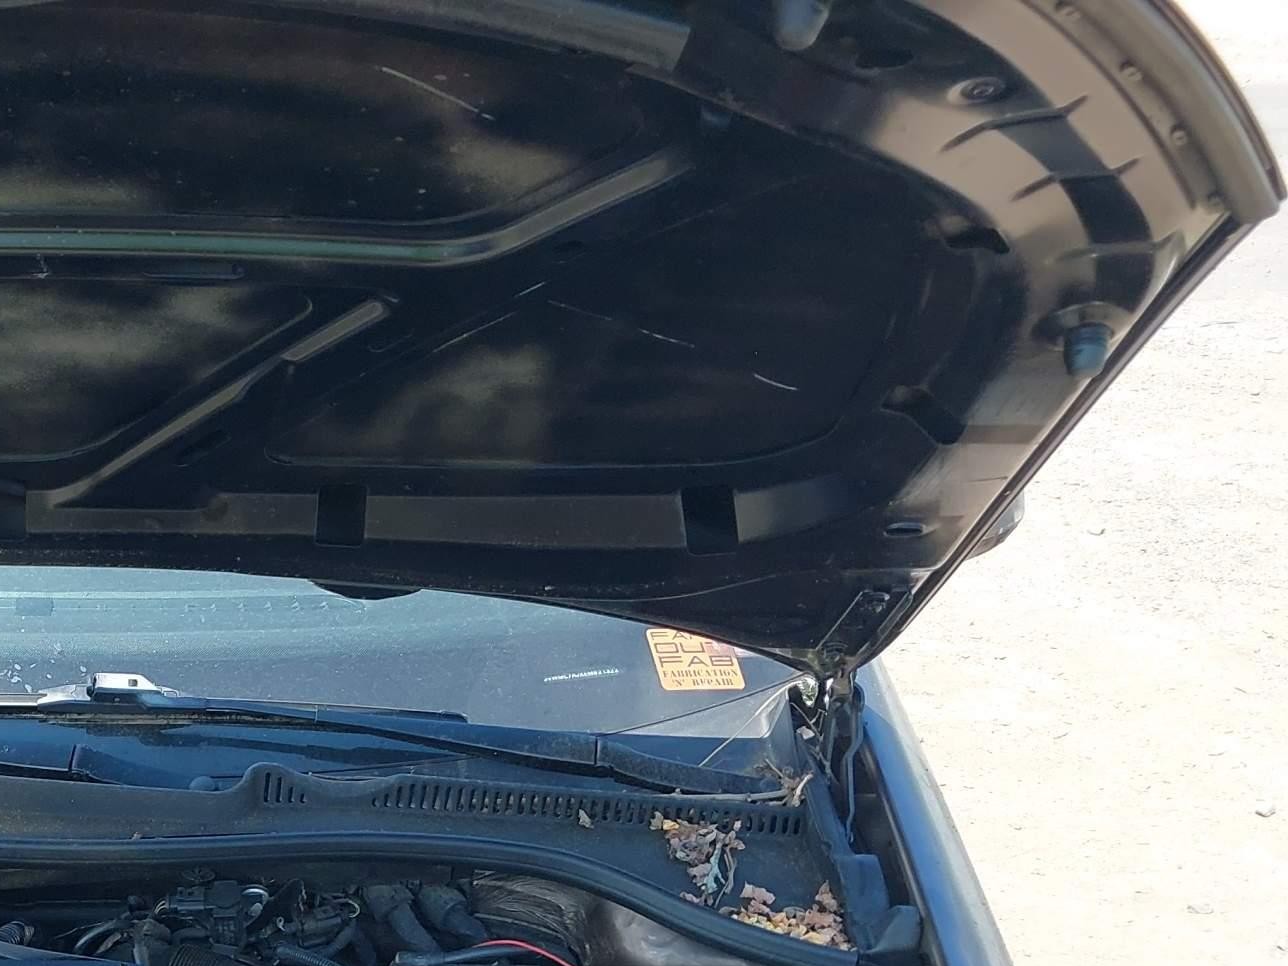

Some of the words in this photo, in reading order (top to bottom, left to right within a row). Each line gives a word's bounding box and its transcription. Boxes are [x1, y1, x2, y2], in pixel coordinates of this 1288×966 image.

[650, 631, 693, 640] FA
[658, 655, 734, 668] FAB
[663, 668, 738, 678] FABRICATION
[692, 678, 734, 687] REPAIR
